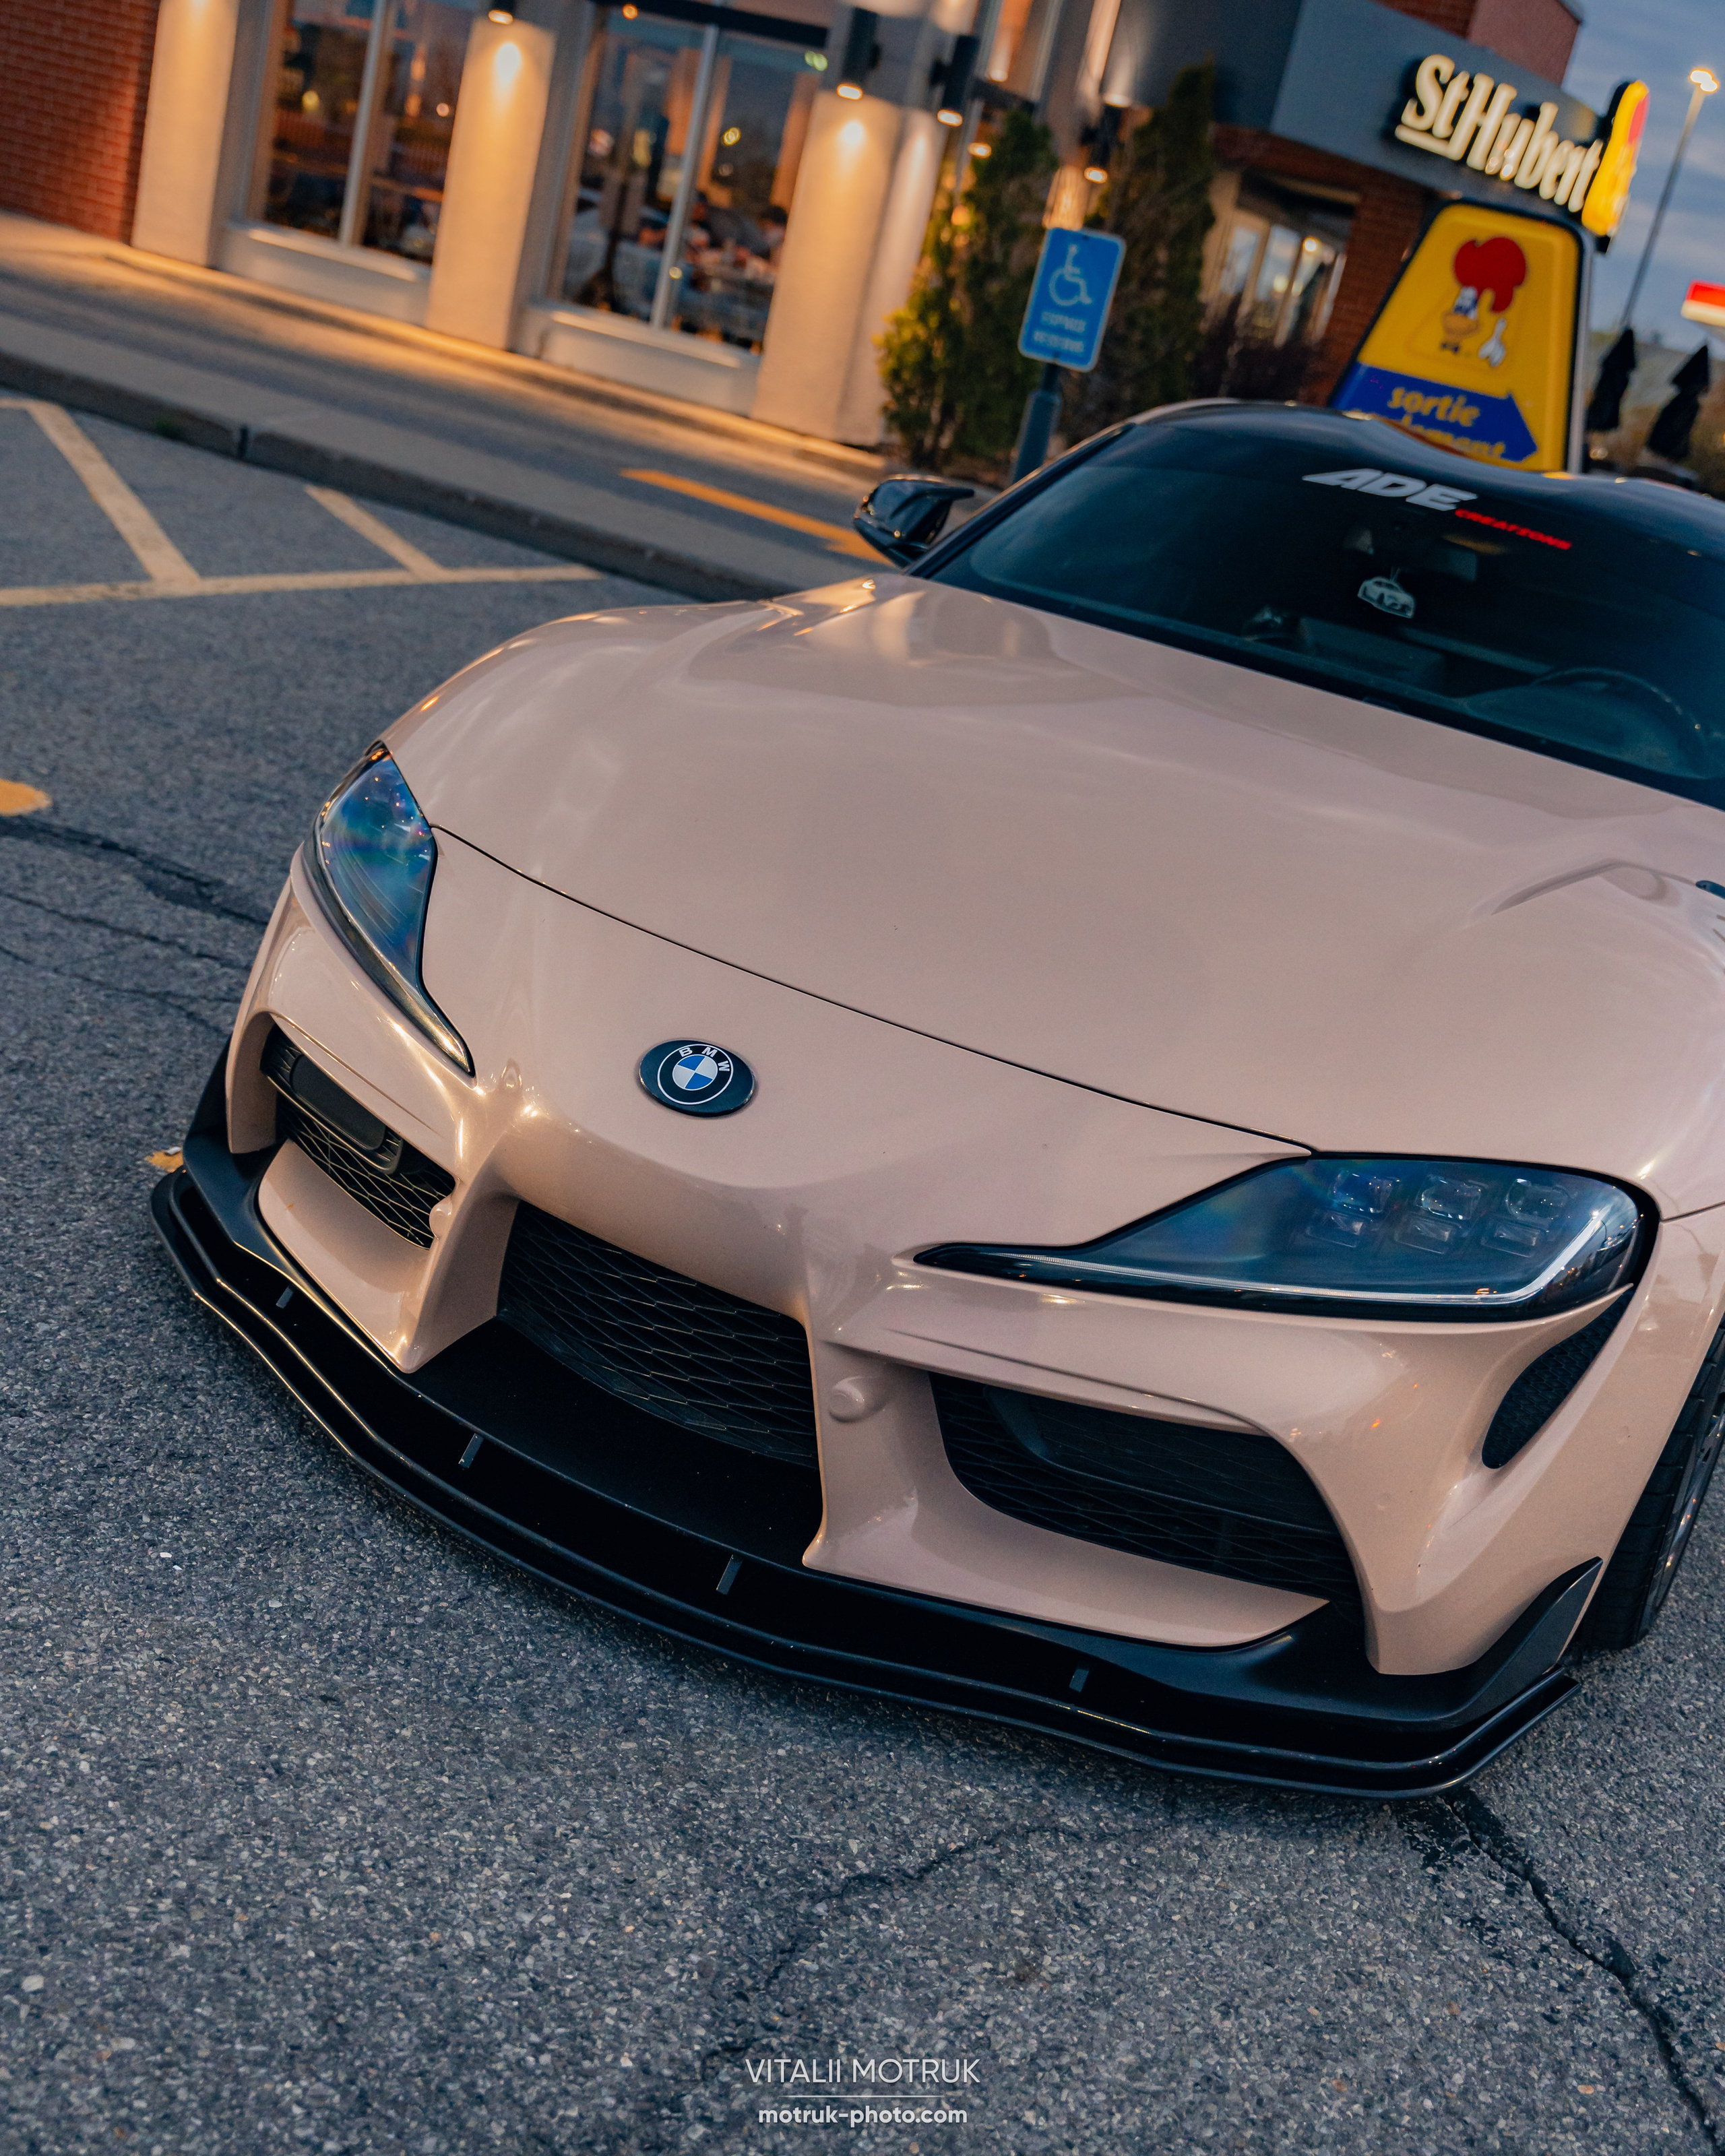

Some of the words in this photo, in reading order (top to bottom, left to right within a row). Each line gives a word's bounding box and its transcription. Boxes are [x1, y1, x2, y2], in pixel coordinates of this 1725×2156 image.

[1387, 387, 1480, 427] sortie
[1302, 468, 1478, 511] ADE
[679, 1047, 730, 1072] BMW
